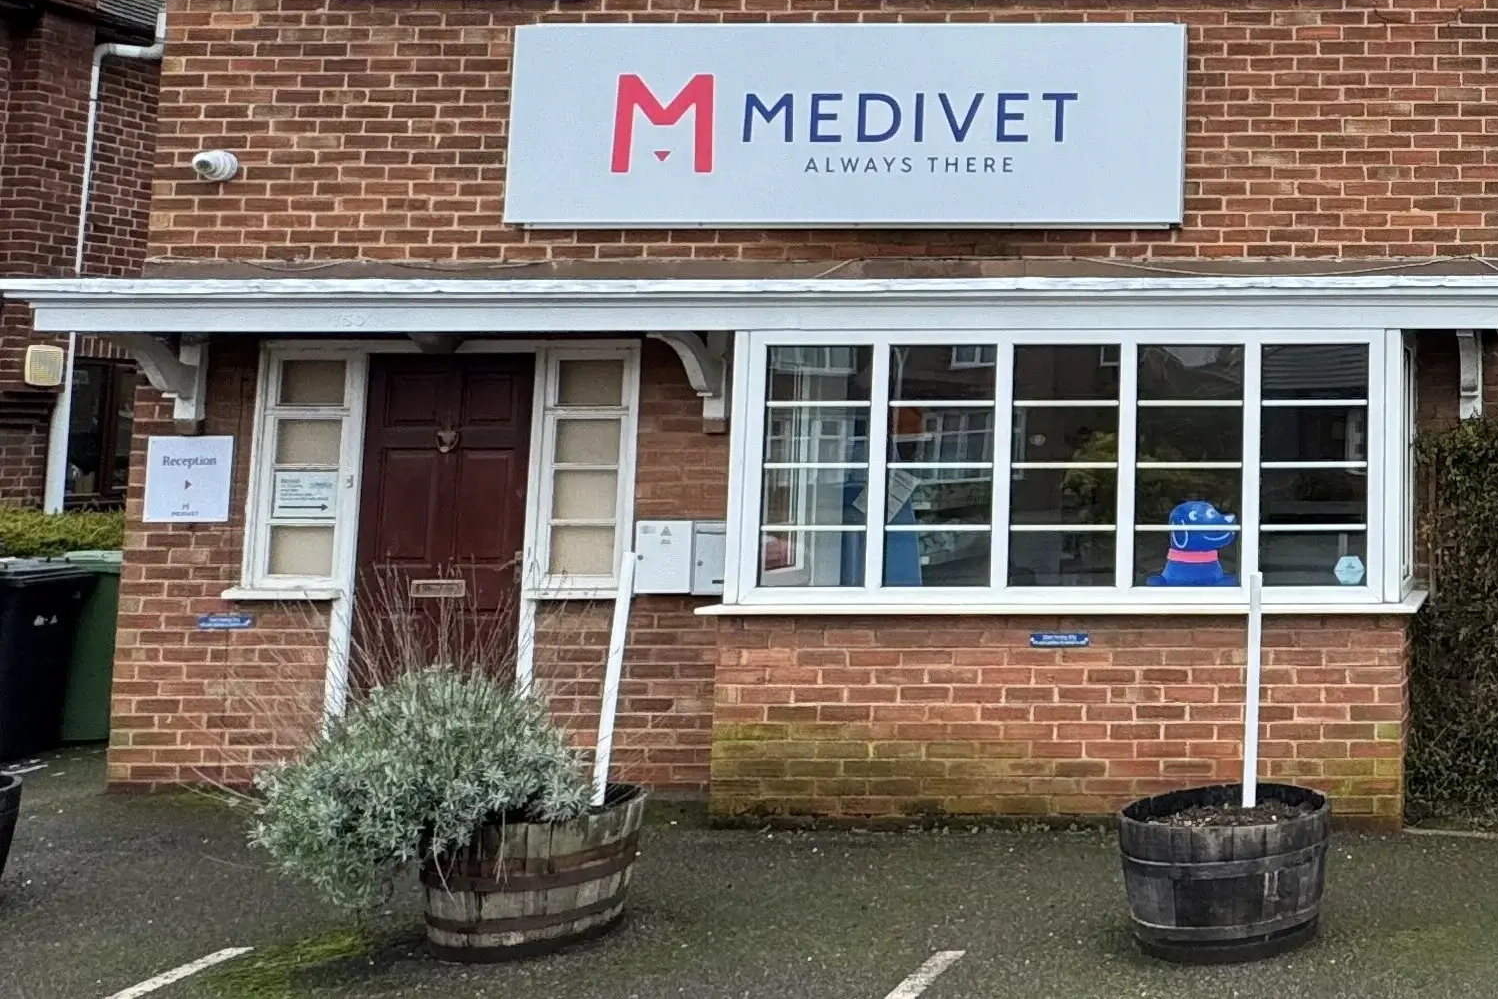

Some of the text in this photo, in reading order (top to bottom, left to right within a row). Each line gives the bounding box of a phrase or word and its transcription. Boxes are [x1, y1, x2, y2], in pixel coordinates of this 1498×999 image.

[742, 92, 1079, 143] MEDIVET
[804, 156, 1014, 173] ALWAYS THERE
[162, 455, 217, 469] Reception
